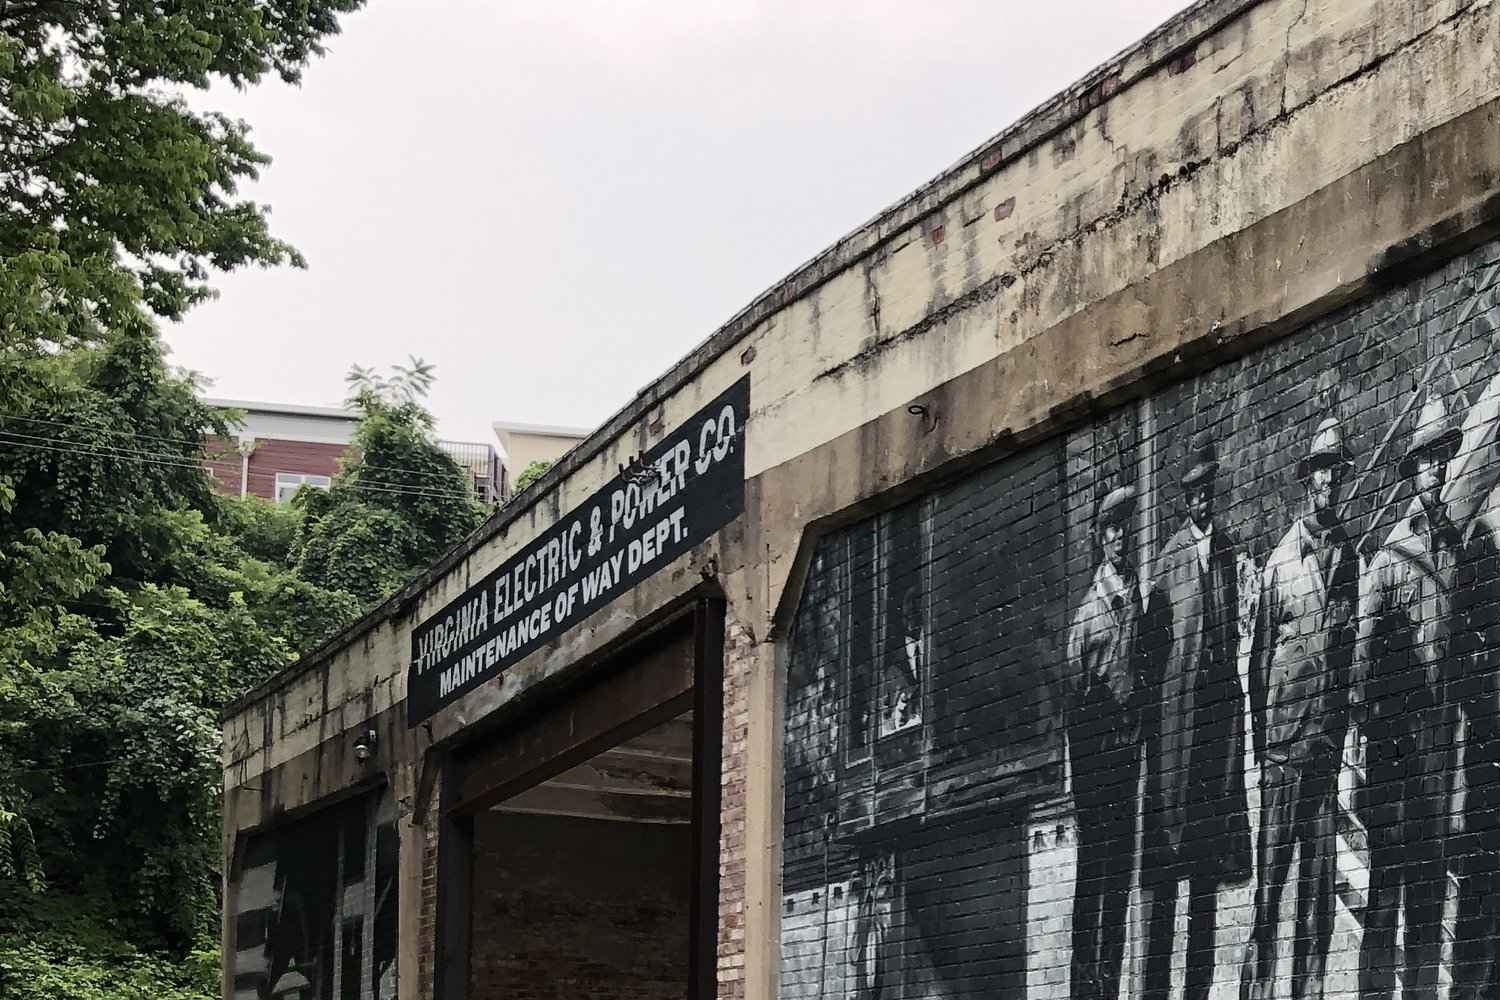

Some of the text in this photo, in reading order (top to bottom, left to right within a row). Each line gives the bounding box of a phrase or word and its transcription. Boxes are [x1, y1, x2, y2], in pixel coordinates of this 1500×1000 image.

[416, 405, 736, 676] VIRGINIA ELECTRIC & POWER CO.
[440, 506, 688, 698] MAINTENANCE OF WAY DEPT.
